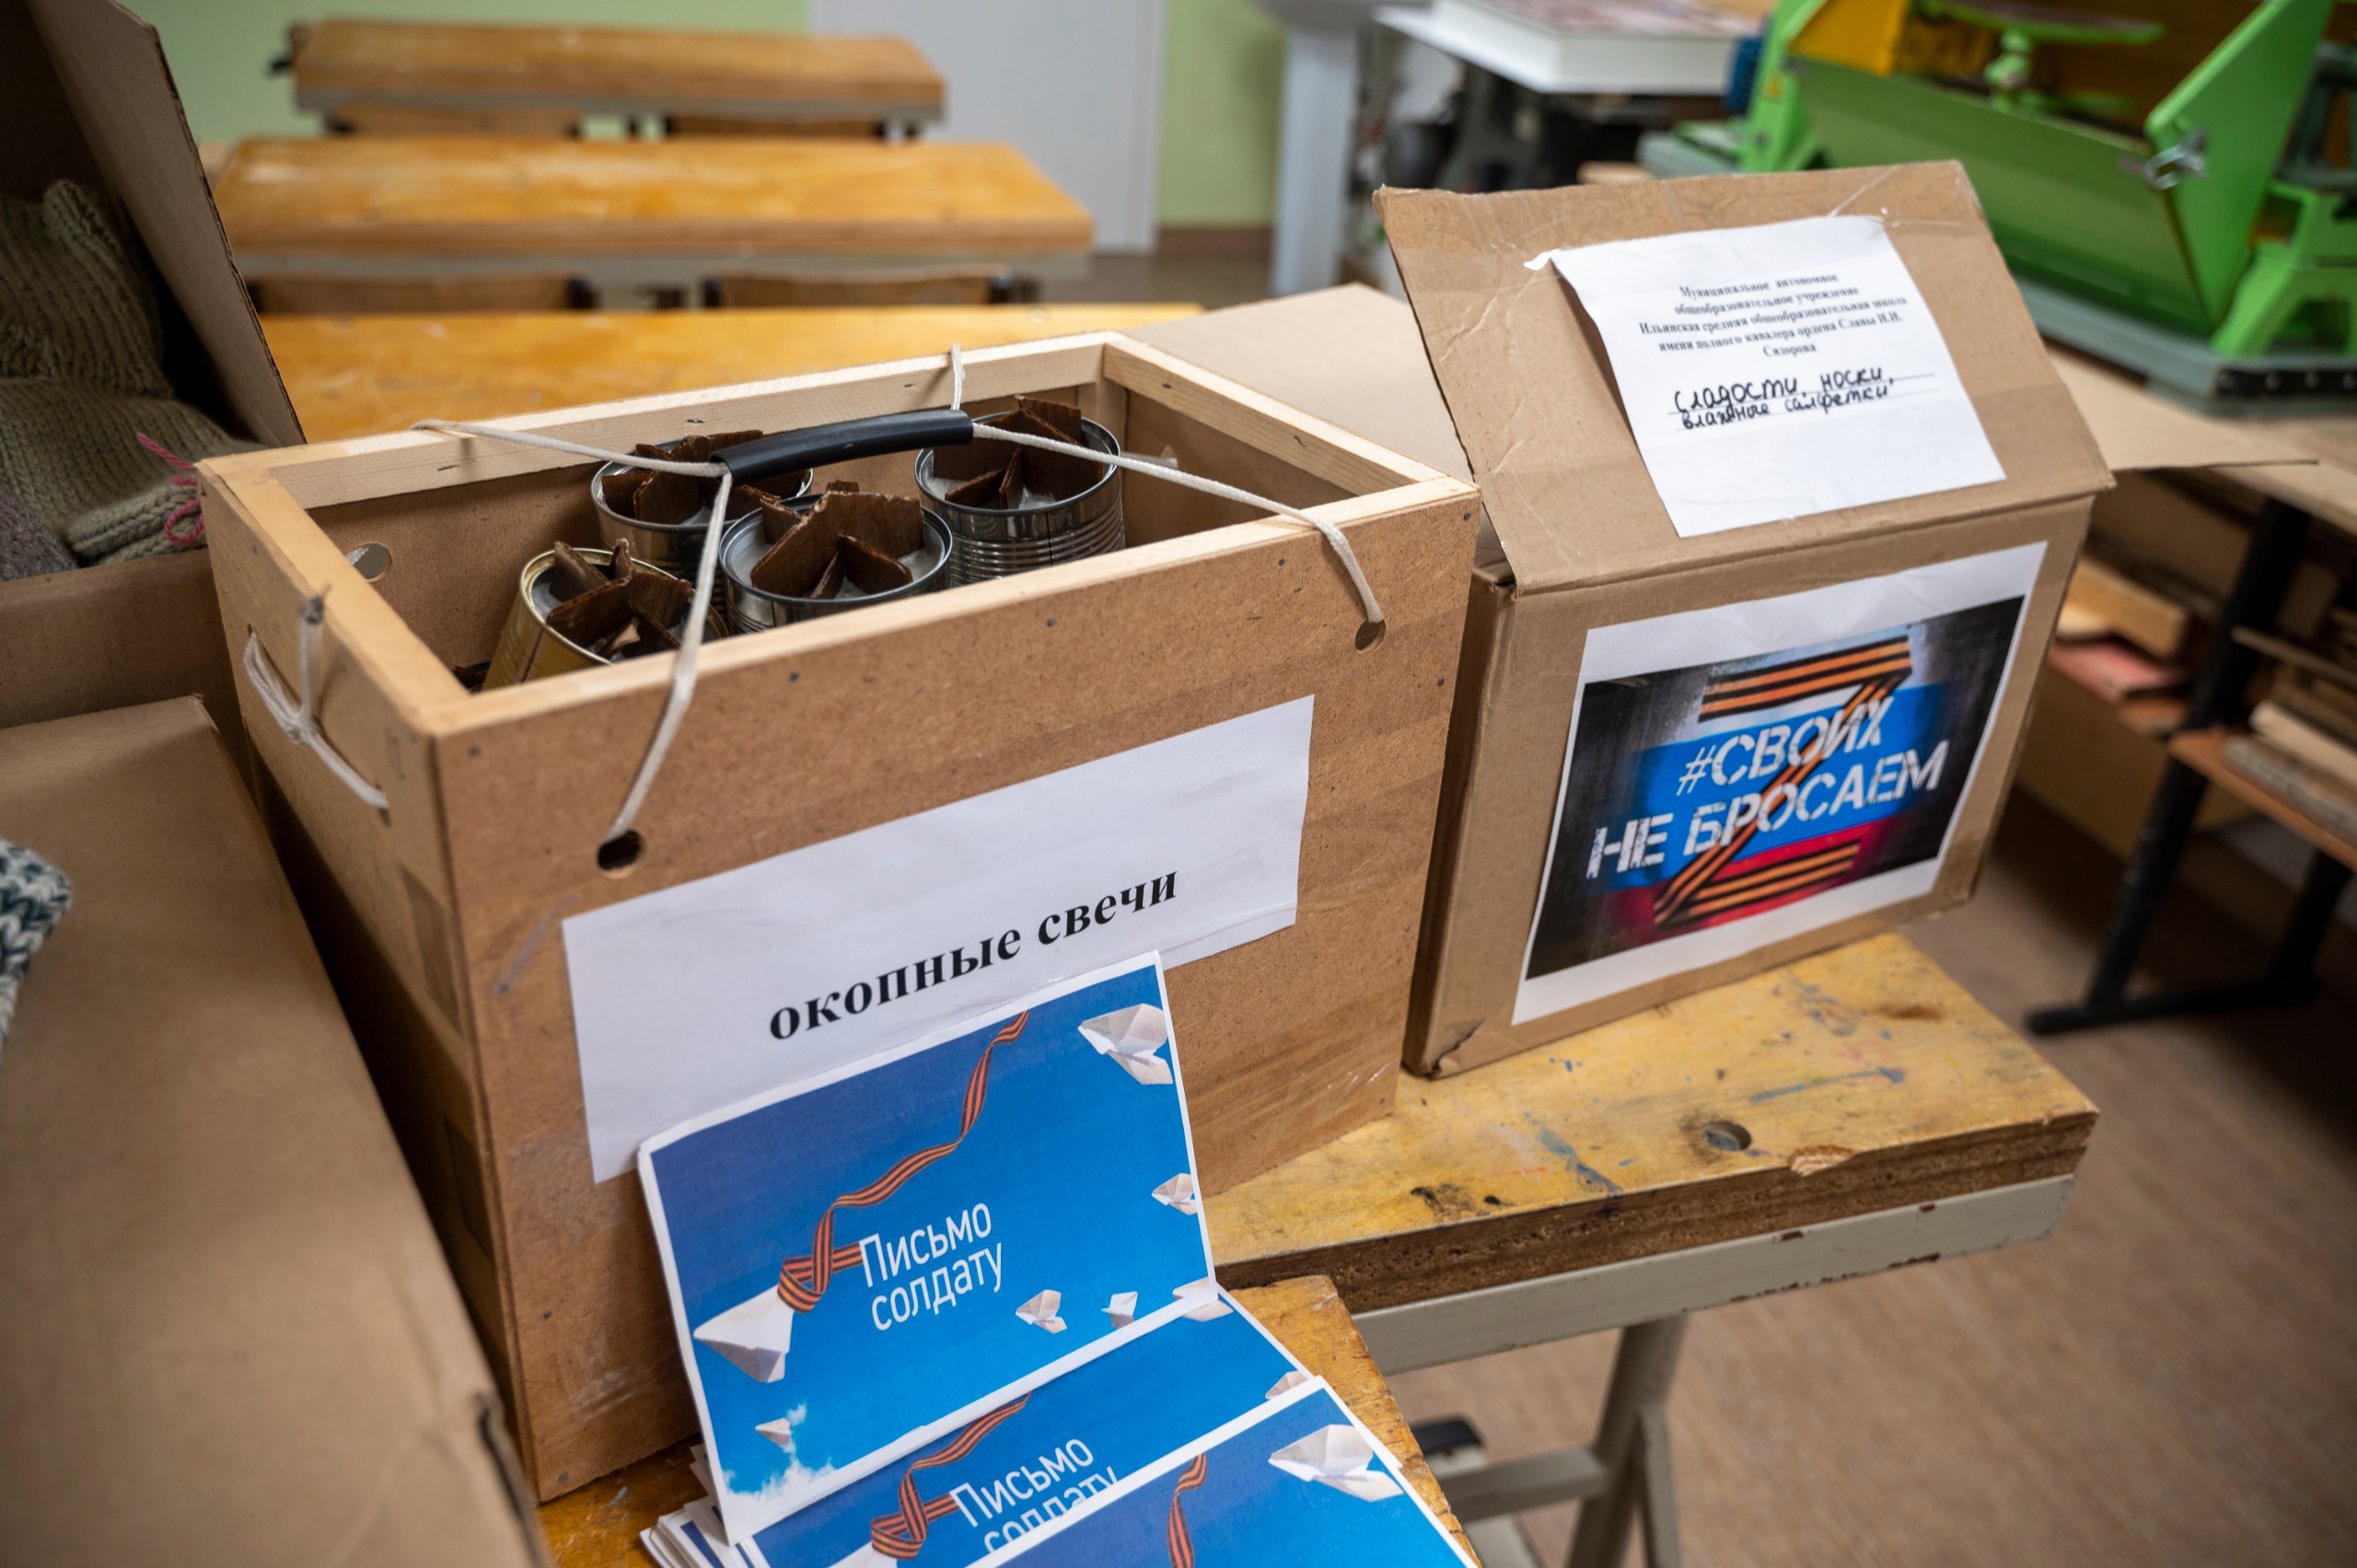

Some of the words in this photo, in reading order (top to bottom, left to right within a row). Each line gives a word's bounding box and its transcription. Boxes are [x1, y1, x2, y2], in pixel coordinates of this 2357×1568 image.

[1639, 322, 1701, 334] Ильинская
[1702, 318, 1748, 333] средняя
[1750, 301, 1870, 324] общеобразовательная
[1872, 296, 1908, 308] школа
[1674, 296, 1794, 316] общеобразовательное
[1795, 286, 1860, 304] учреждение
[1678, 281, 1770, 300] Муниципальное
[1775, 273, 1839, 288] автономное
[1658, 341, 1694, 352] имени
[1696, 335, 1742, 349] полного
[1745, 329, 1795, 343] кавалера
[1797, 321, 1837, 338] ордена
[1838, 317, 1876, 330] Славы
[1762, 343, 1817, 358] Сидорова
[1784, 385, 1887, 414] салфетки
[1677, 697, 1894, 796] #СВОИХ
[1585, 812, 1674, 879] НЕ
[1683, 740, 1949, 856] БРОСАЕМ
[770, 929, 1021, 1040] окопные
[1038, 871, 1178, 946] свечи
[859, 1202, 992, 1287] Письмо
[872, 1242, 1002, 1330] солдату
[948, 1438, 1094, 1527] Письмо
